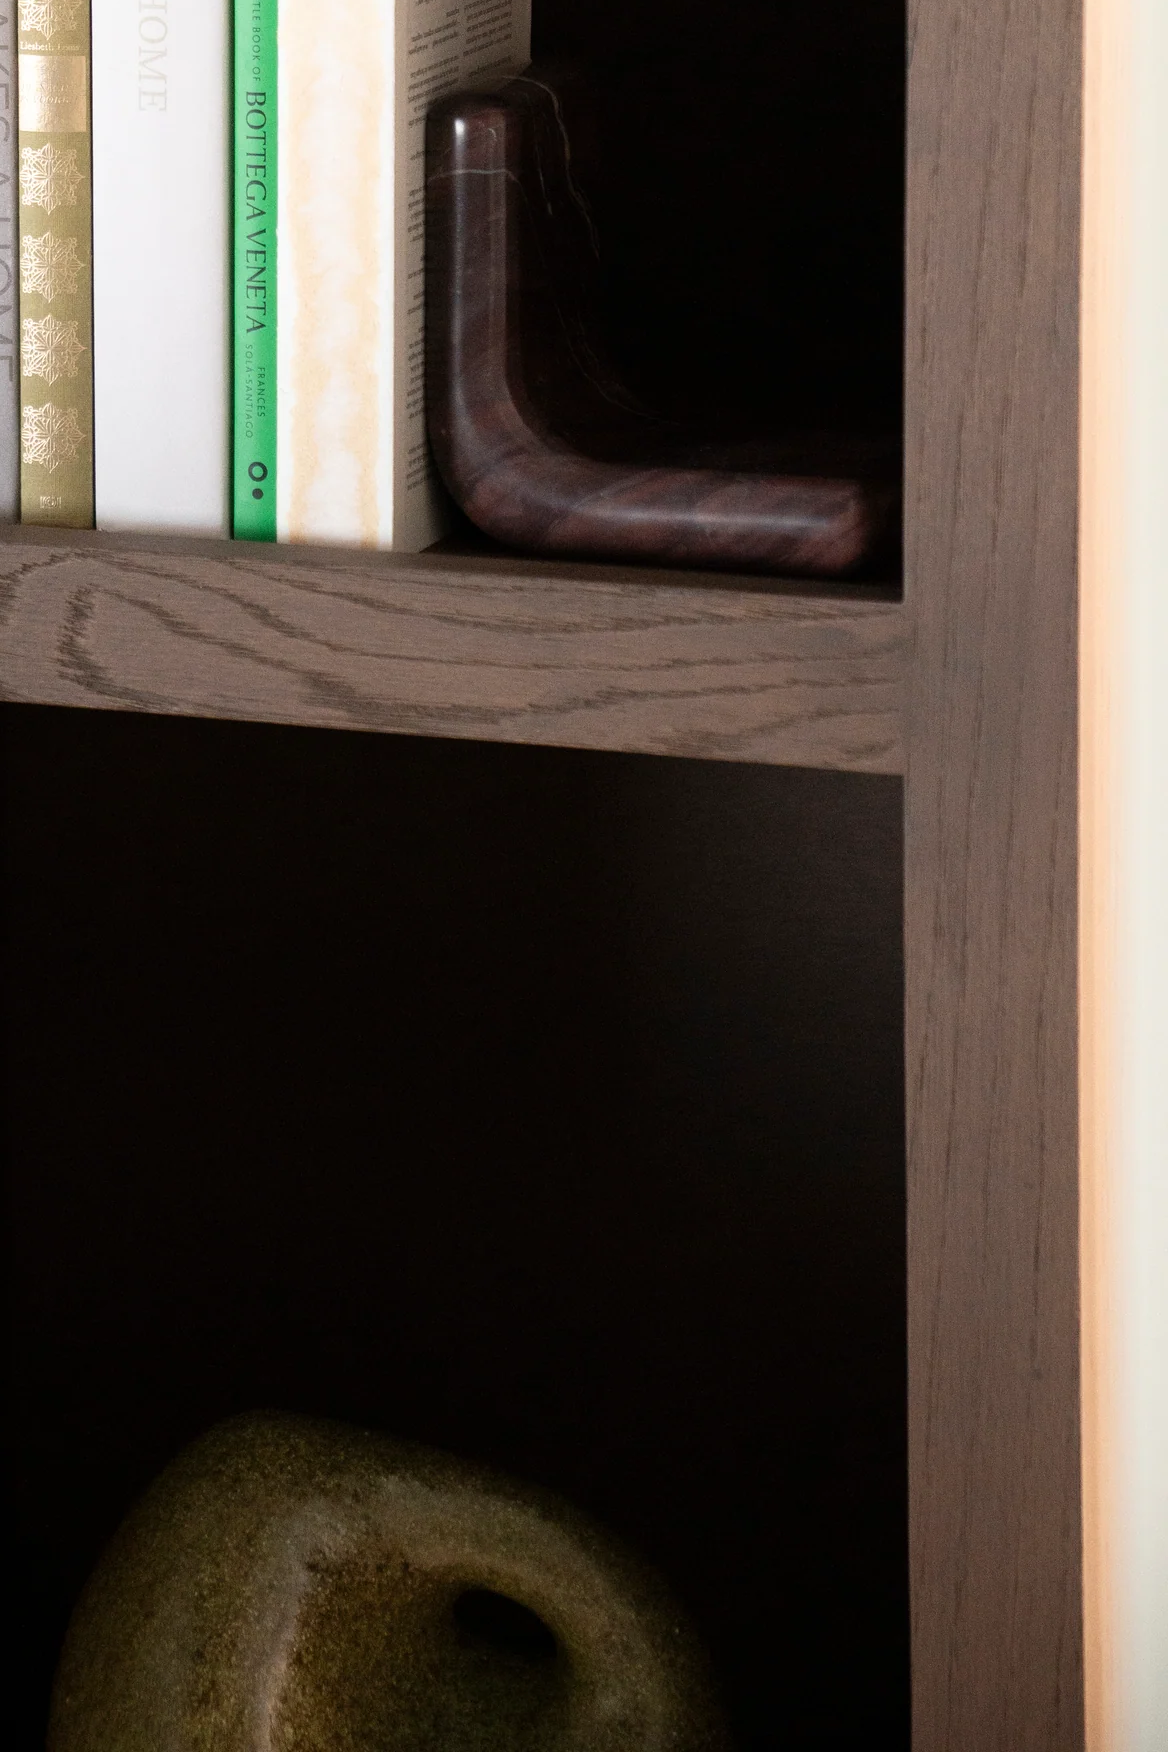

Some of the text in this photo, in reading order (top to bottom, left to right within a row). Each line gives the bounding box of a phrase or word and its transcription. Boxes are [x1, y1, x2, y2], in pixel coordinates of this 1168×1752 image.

[252, 27, 261, 61] BOOK
[252, 66, 261, 82] OF
[245, 91, 267, 334] BOTTEGA VENETA
[257, 367, 266, 417] FRANCES
